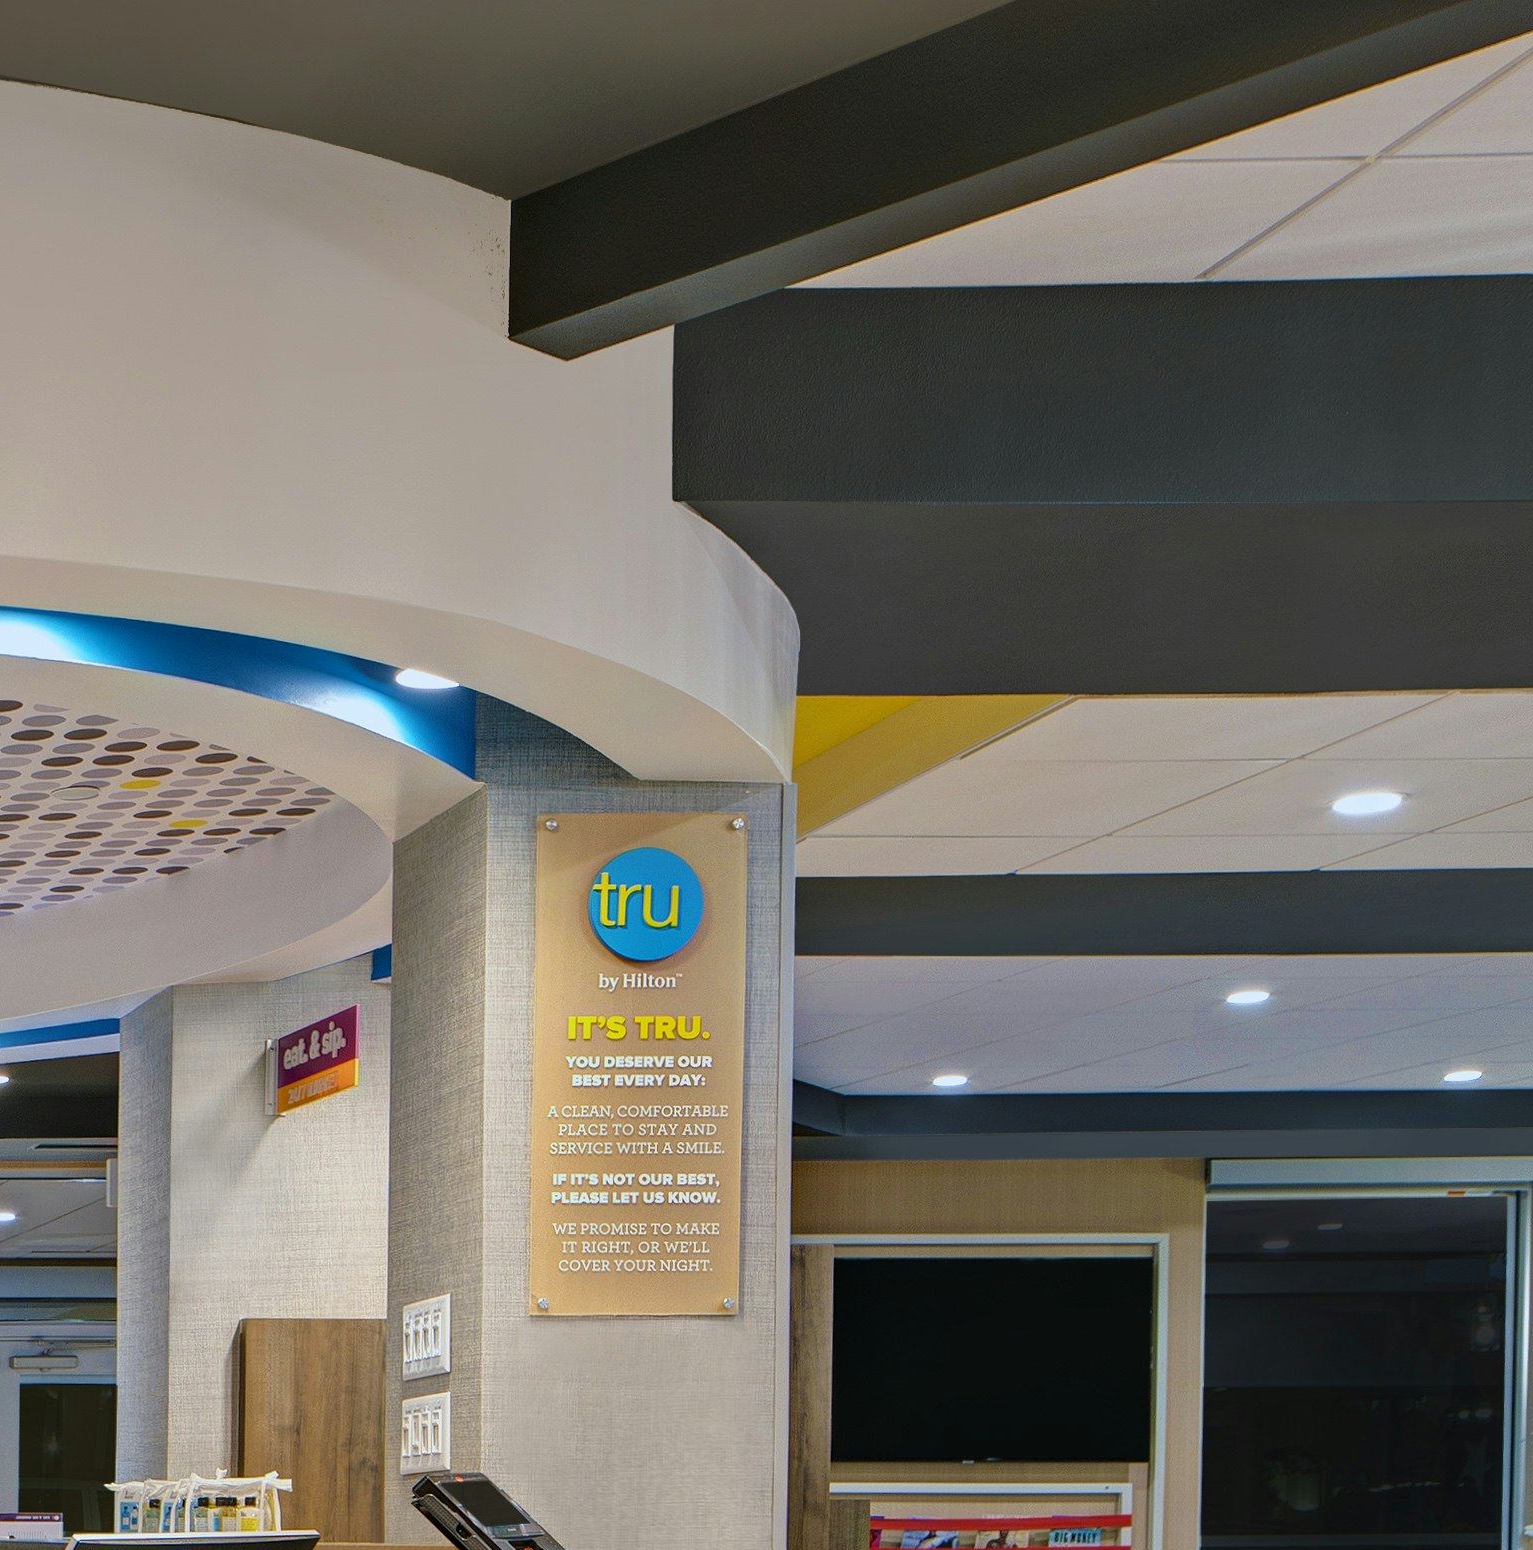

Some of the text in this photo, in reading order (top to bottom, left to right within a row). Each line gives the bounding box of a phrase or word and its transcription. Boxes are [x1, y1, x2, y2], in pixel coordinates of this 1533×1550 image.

[593, 872, 679, 928] tru
[598, 973, 620, 993] by
[567, 1015, 711, 1041] IT'S TRU.
[309, 1029, 321, 1060] &
[566, 1055, 713, 1069] YOU DESERVE OUR
[571, 1074, 706, 1088] BEST EVERY DAY:
[547, 1105, 729, 1120] A CLEAN, COMFORTABLE
[558, 1123, 717, 1137] PLACE TO STAY AND
[549, 1142, 725, 1155] SERVICE WITH A SMILE.
[552, 1173, 721, 1188] IF IT'S NOT OUR BEST,
[551, 1192, 722, 1205] PLEASE LET US KNOW.
[552, 1223, 720, 1236] WE PROMISE TO MAKE
[561, 1241, 710, 1256] IT RIGHT, OR WE'LL
[558, 1259, 713, 1273] COVER YOUR NIGHT.
[1053, 1532, 1097, 1544] BIG MONEY
